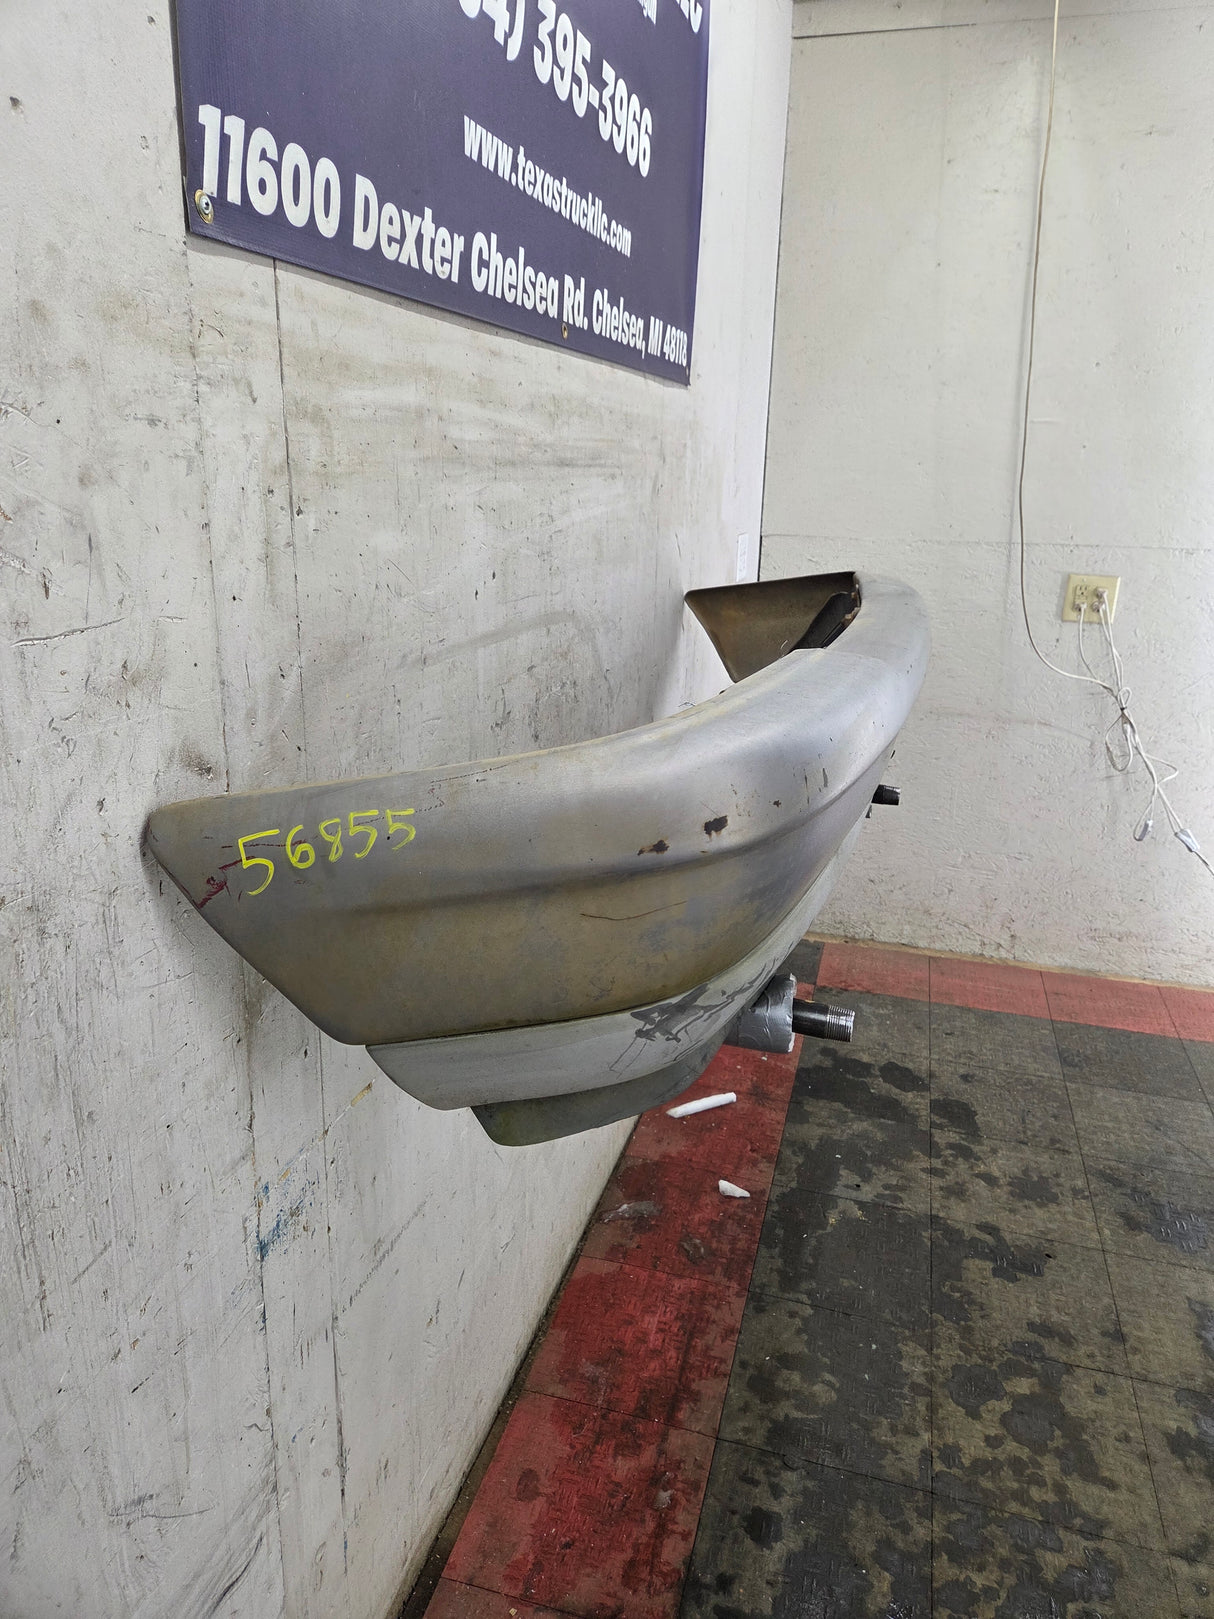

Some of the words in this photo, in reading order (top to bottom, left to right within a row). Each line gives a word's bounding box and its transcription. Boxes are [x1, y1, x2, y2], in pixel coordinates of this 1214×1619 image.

[534, 0, 652, 177] 395-3966
[198, 104, 341, 238] 11600
[352, 173, 465, 284] Dexter
[470, 231, 559, 319] Chelsea
[563, 274, 588, 331] Rd.
[592, 288, 646, 359] Chelsea,
[649, 316, 663, 357] MI
[663, 324, 687, 367] 48118
[464, 115, 632, 258] www.texastruckllc.com
[238, 808, 416, 895] 56855
